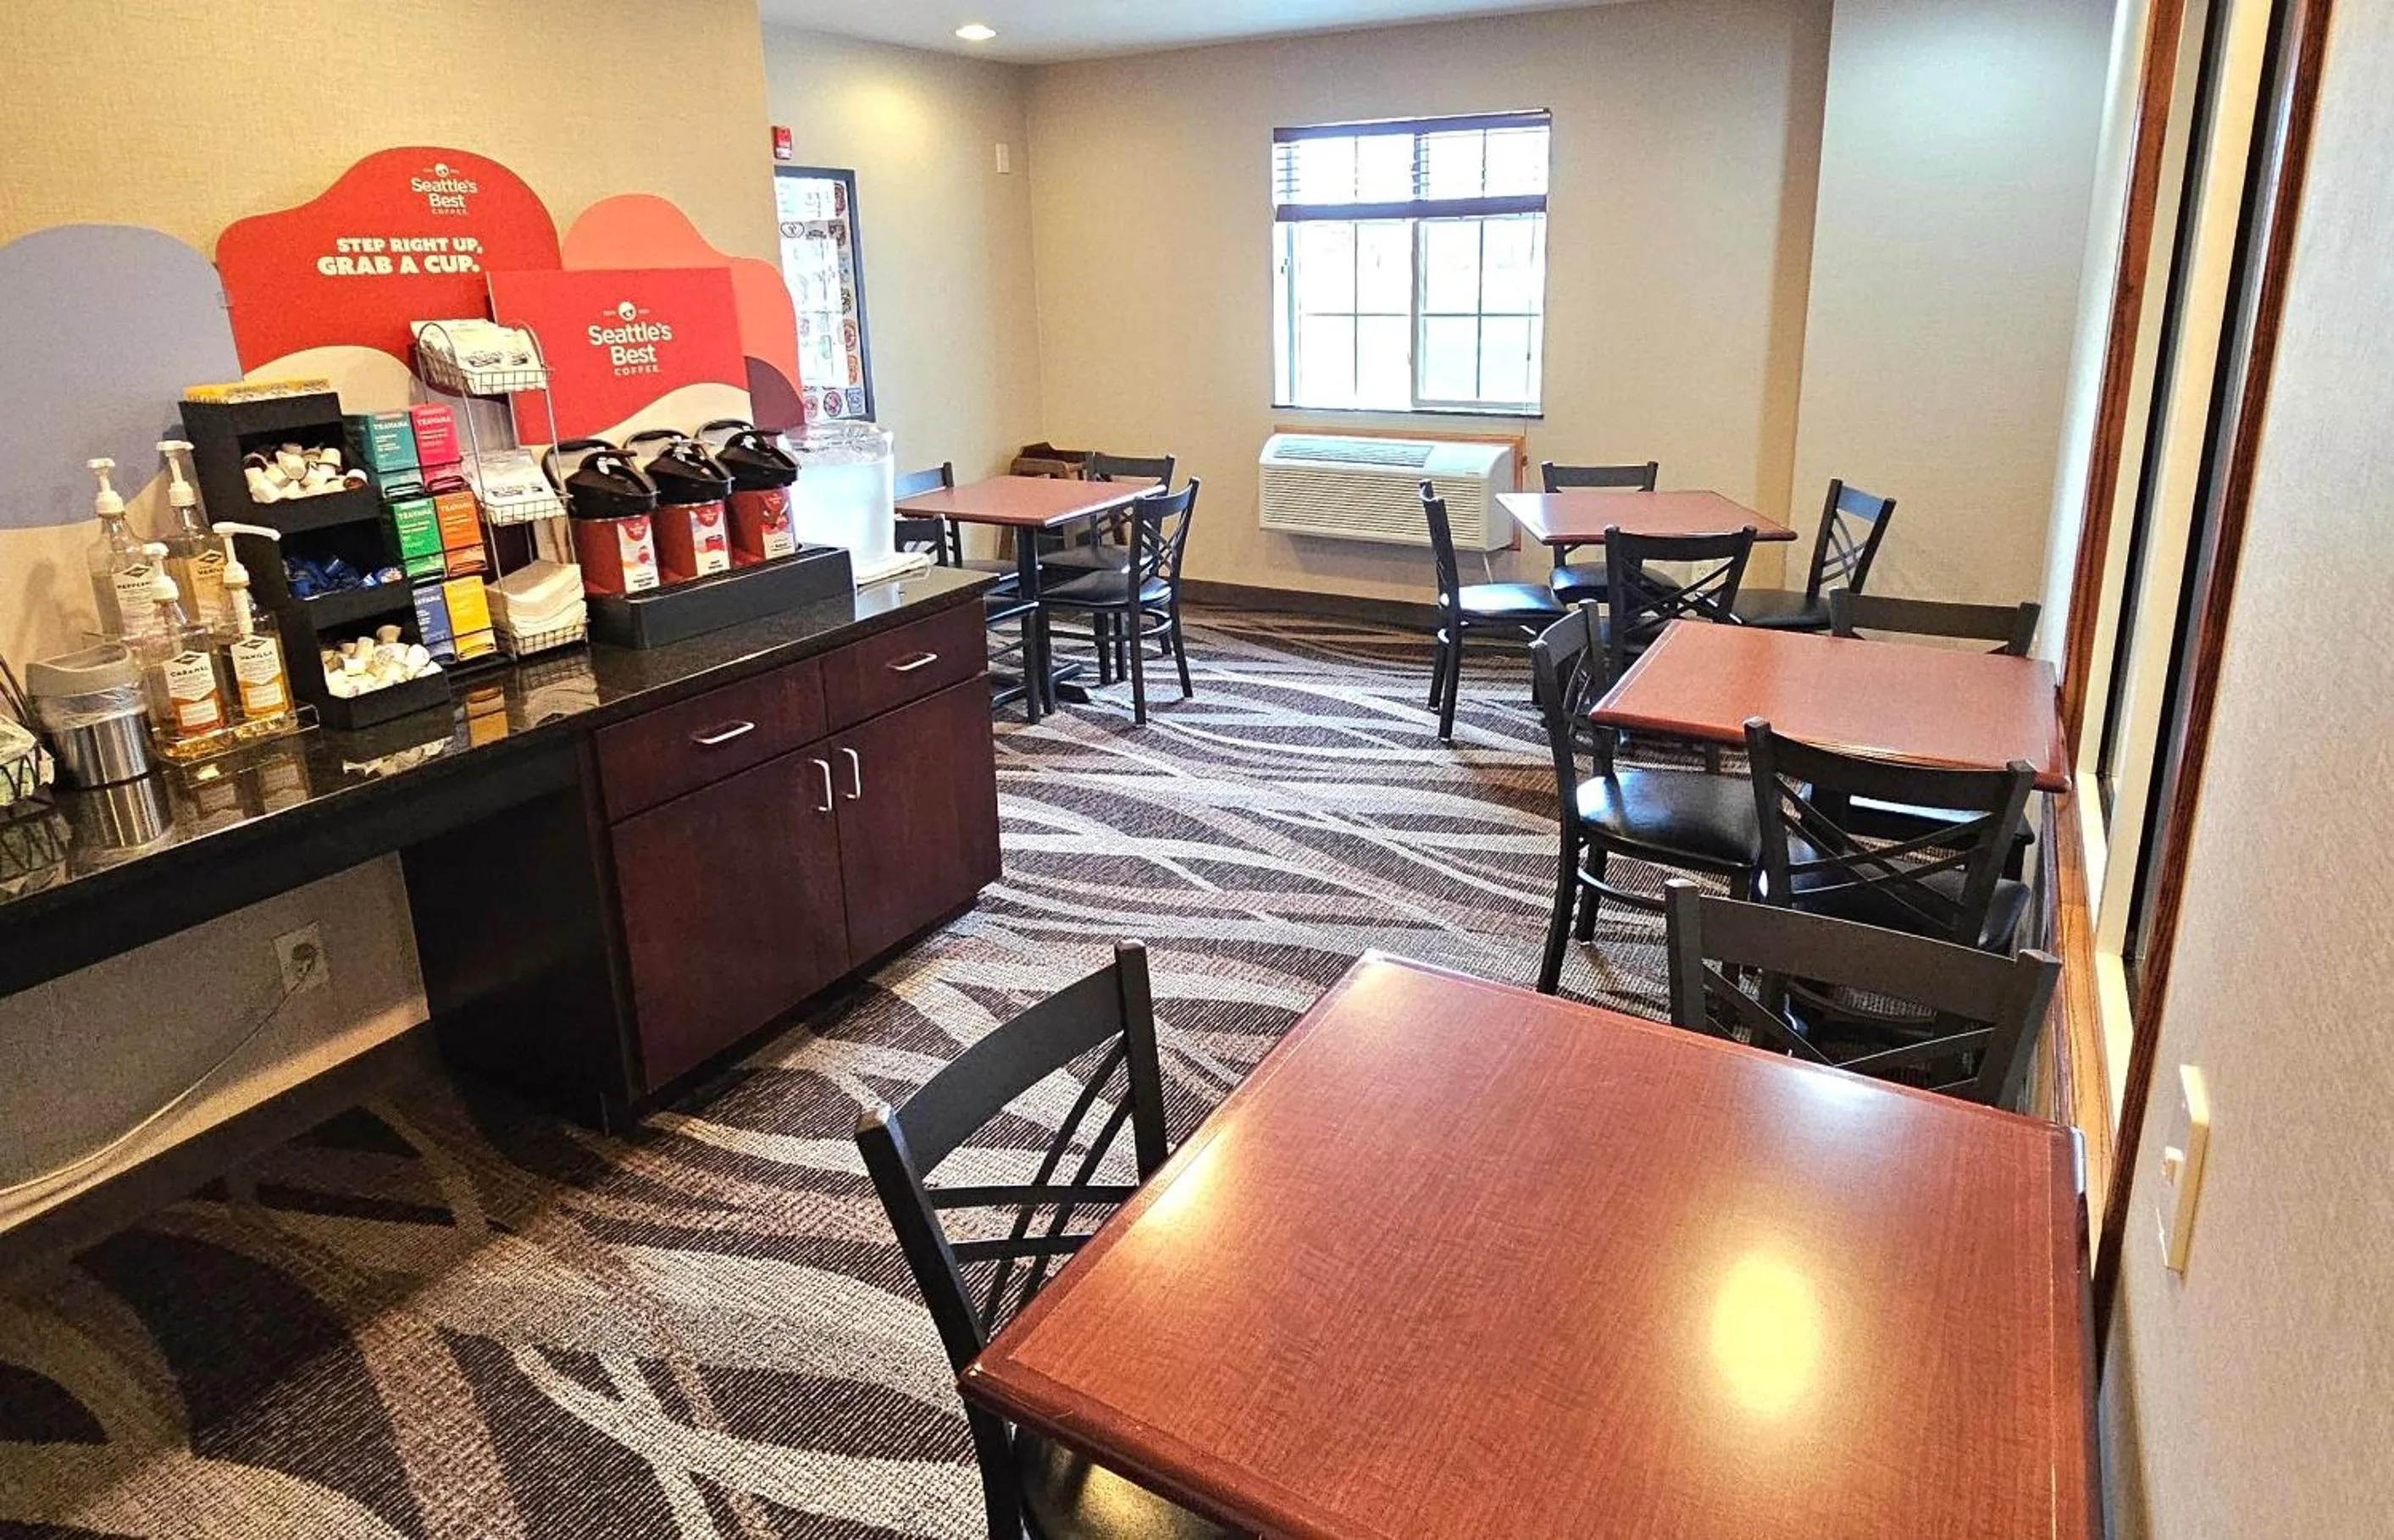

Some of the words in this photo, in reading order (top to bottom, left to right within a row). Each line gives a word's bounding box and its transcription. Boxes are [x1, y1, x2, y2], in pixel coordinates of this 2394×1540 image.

[411, 178, 478, 192] Seattle's
[429, 193, 465, 208] Best
[337, 238, 385, 252] STEP
[390, 237, 449, 252] RIGHT
[453, 237, 483, 253] UP,
[318, 256, 393, 275] GRAB
[401, 256, 419, 274] A
[424, 255, 480, 273] CUP.
[588, 322, 673, 346] Seattle's
[611, 344, 657, 366] Best
[614, 365, 659, 375] COFFEE
